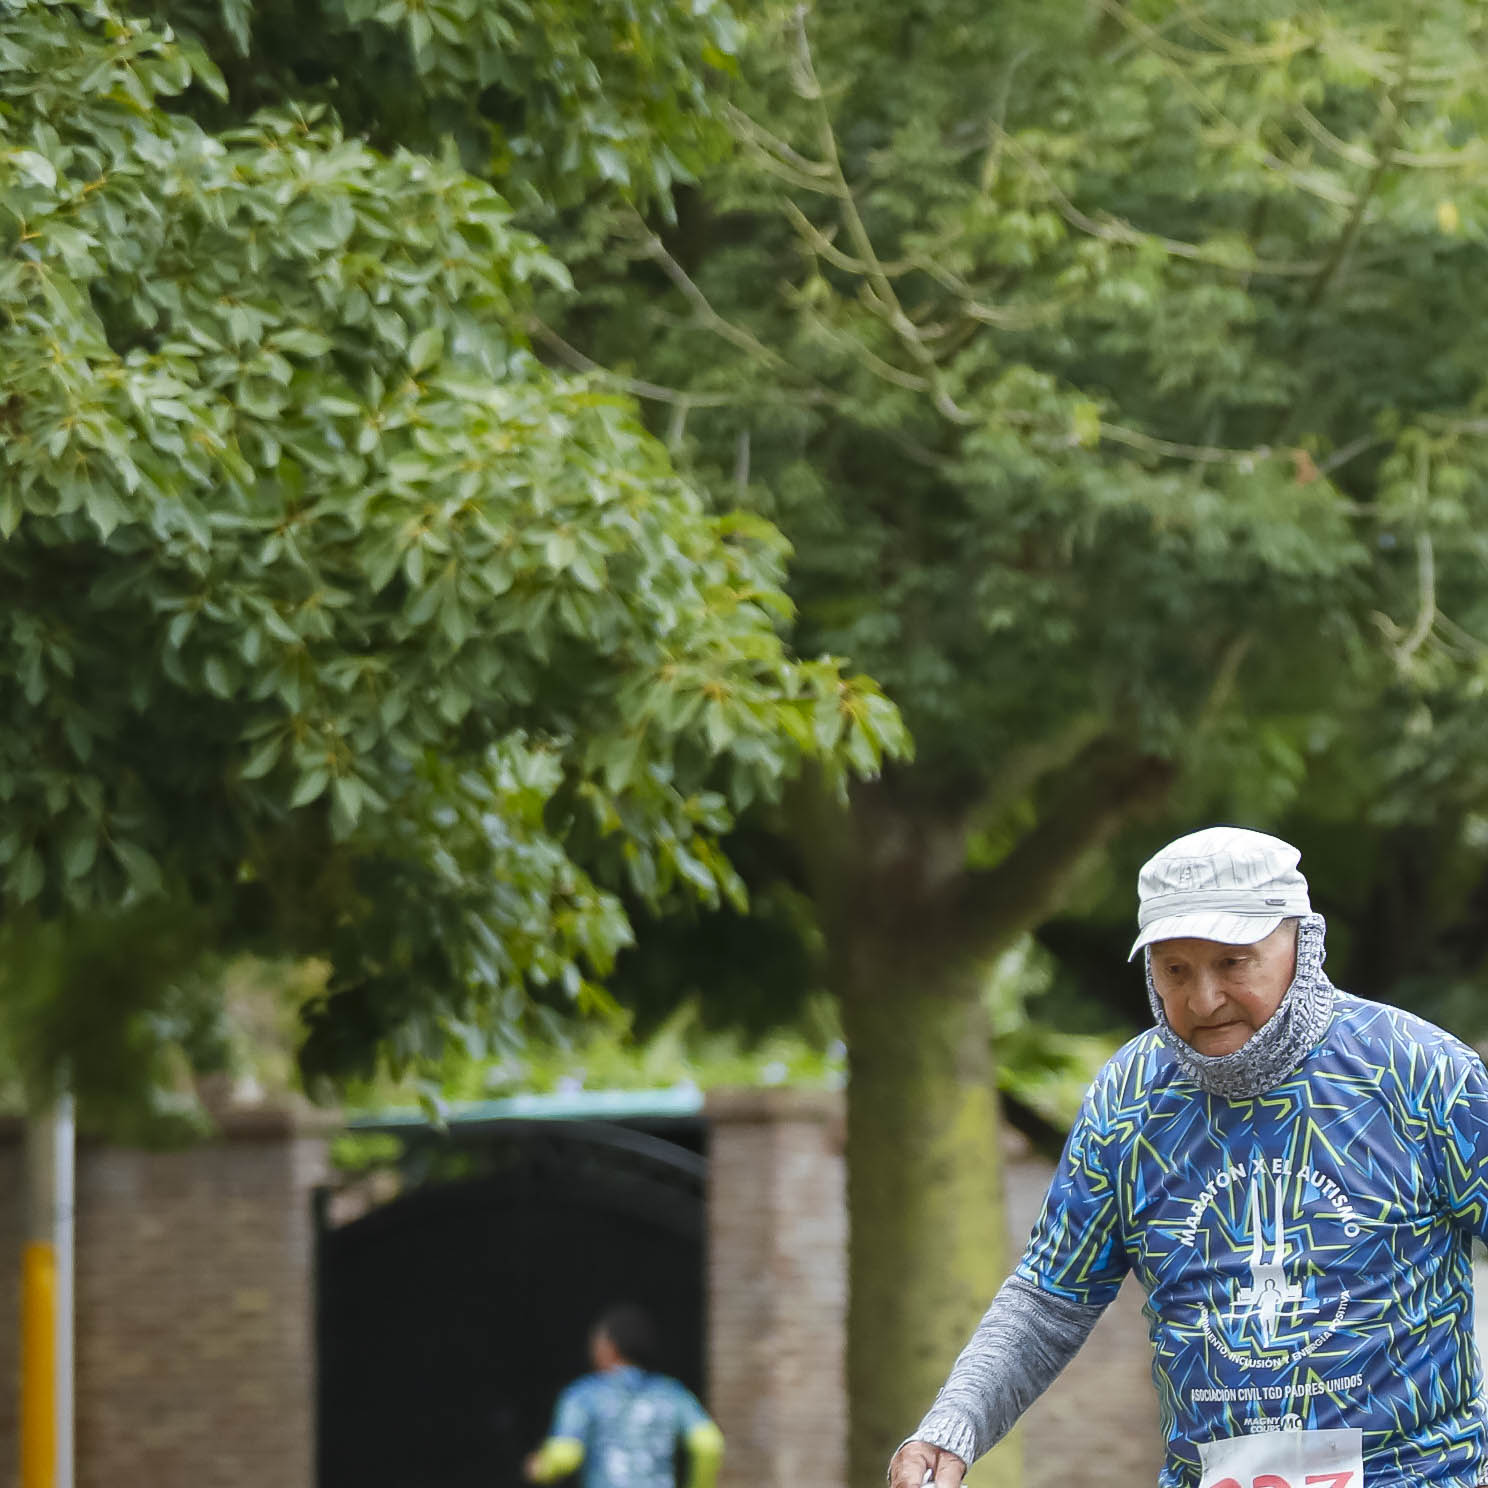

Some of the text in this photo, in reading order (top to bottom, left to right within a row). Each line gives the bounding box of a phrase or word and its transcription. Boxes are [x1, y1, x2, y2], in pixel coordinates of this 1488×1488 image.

[1180, 1158, 1362, 1247] MARATÓN X EL AUTISMO
[1228, 1354, 1282, 1369] INCLUSIÓN
[1292, 1331, 1333, 1362] ENERGÍA
[1191, 1373, 1364, 1402] ASOCIACIÓN CIVIL TGD PADRES UNIDOS
